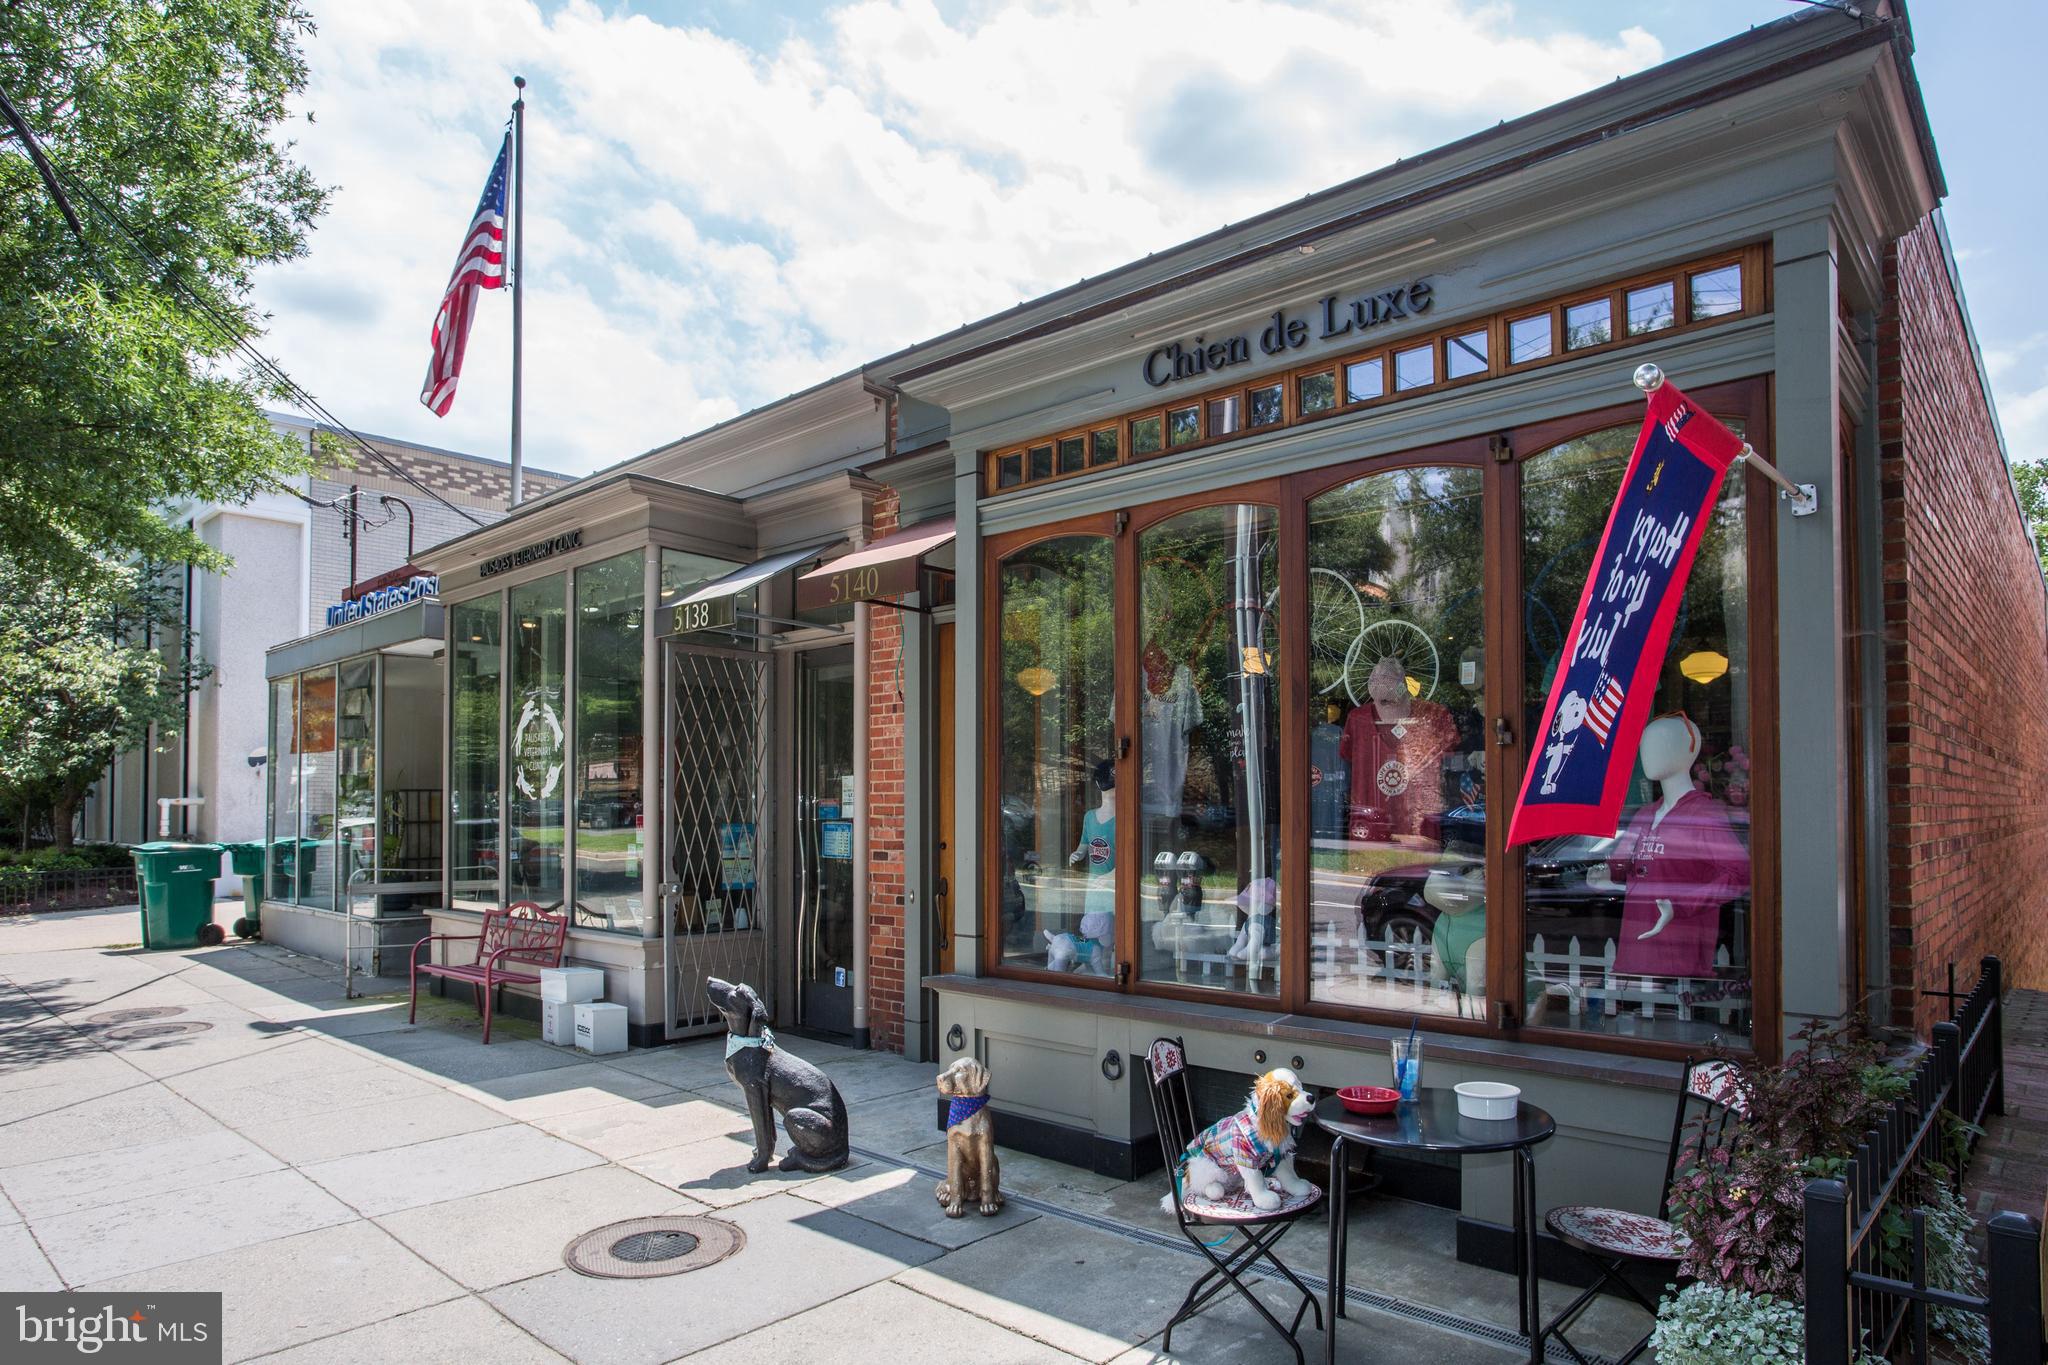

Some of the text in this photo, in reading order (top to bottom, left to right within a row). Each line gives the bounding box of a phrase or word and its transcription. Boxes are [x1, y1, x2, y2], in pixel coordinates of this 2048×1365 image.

[1142, 280, 1432, 387] Chien de Luxe
[480, 528, 583, 577] PALISADES VETERINARY CLINIC
[829, 567, 879, 602] 5140
[326, 597, 365, 628] United
[363, 584, 409, 617] States
[674, 601, 709, 632] 5138
[1640, 842, 1664, 854] run
